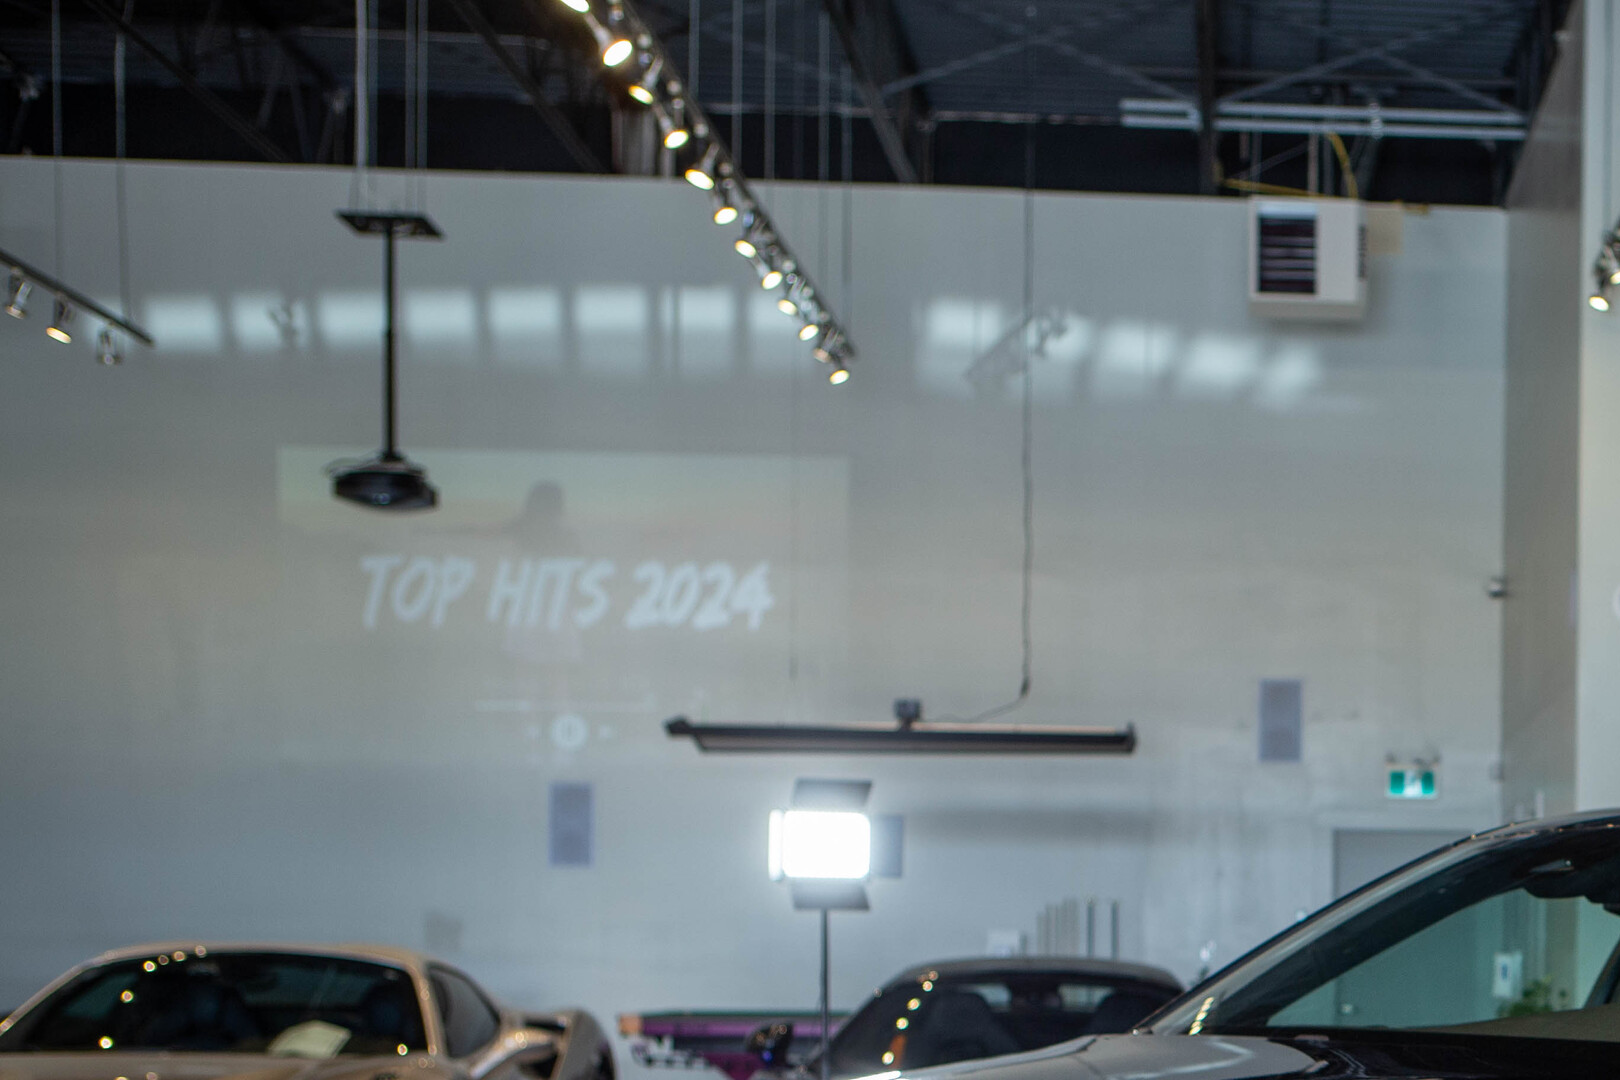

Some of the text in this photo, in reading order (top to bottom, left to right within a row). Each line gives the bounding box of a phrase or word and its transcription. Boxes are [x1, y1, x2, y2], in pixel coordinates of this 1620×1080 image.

[360, 554, 775, 632] TOP HITS 2024
